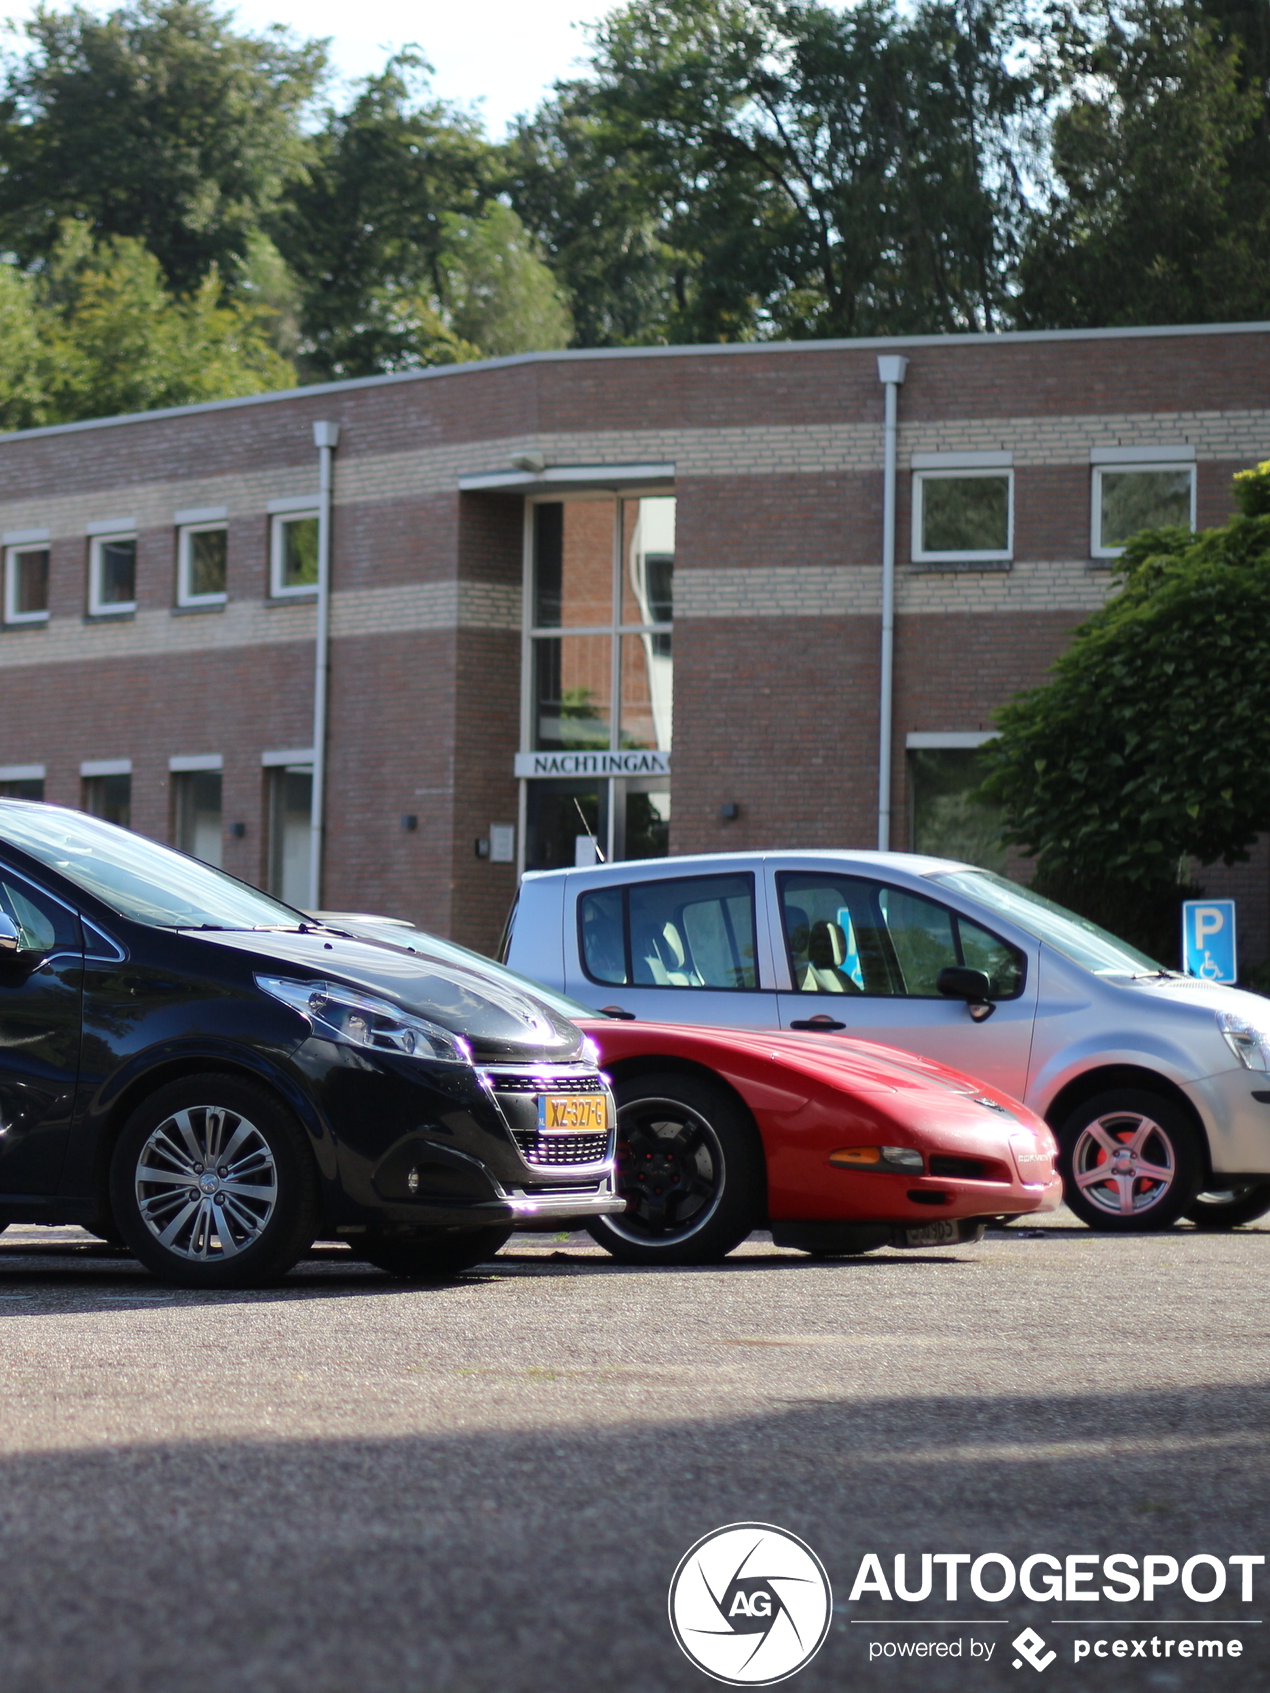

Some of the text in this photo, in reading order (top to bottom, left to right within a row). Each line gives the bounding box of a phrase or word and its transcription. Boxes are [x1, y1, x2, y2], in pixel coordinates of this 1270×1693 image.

[534, 755, 670, 774] NACHTINGAN
[1195, 908, 1224, 950] P
[551, 1099, 602, 1127] XZ-327-G
